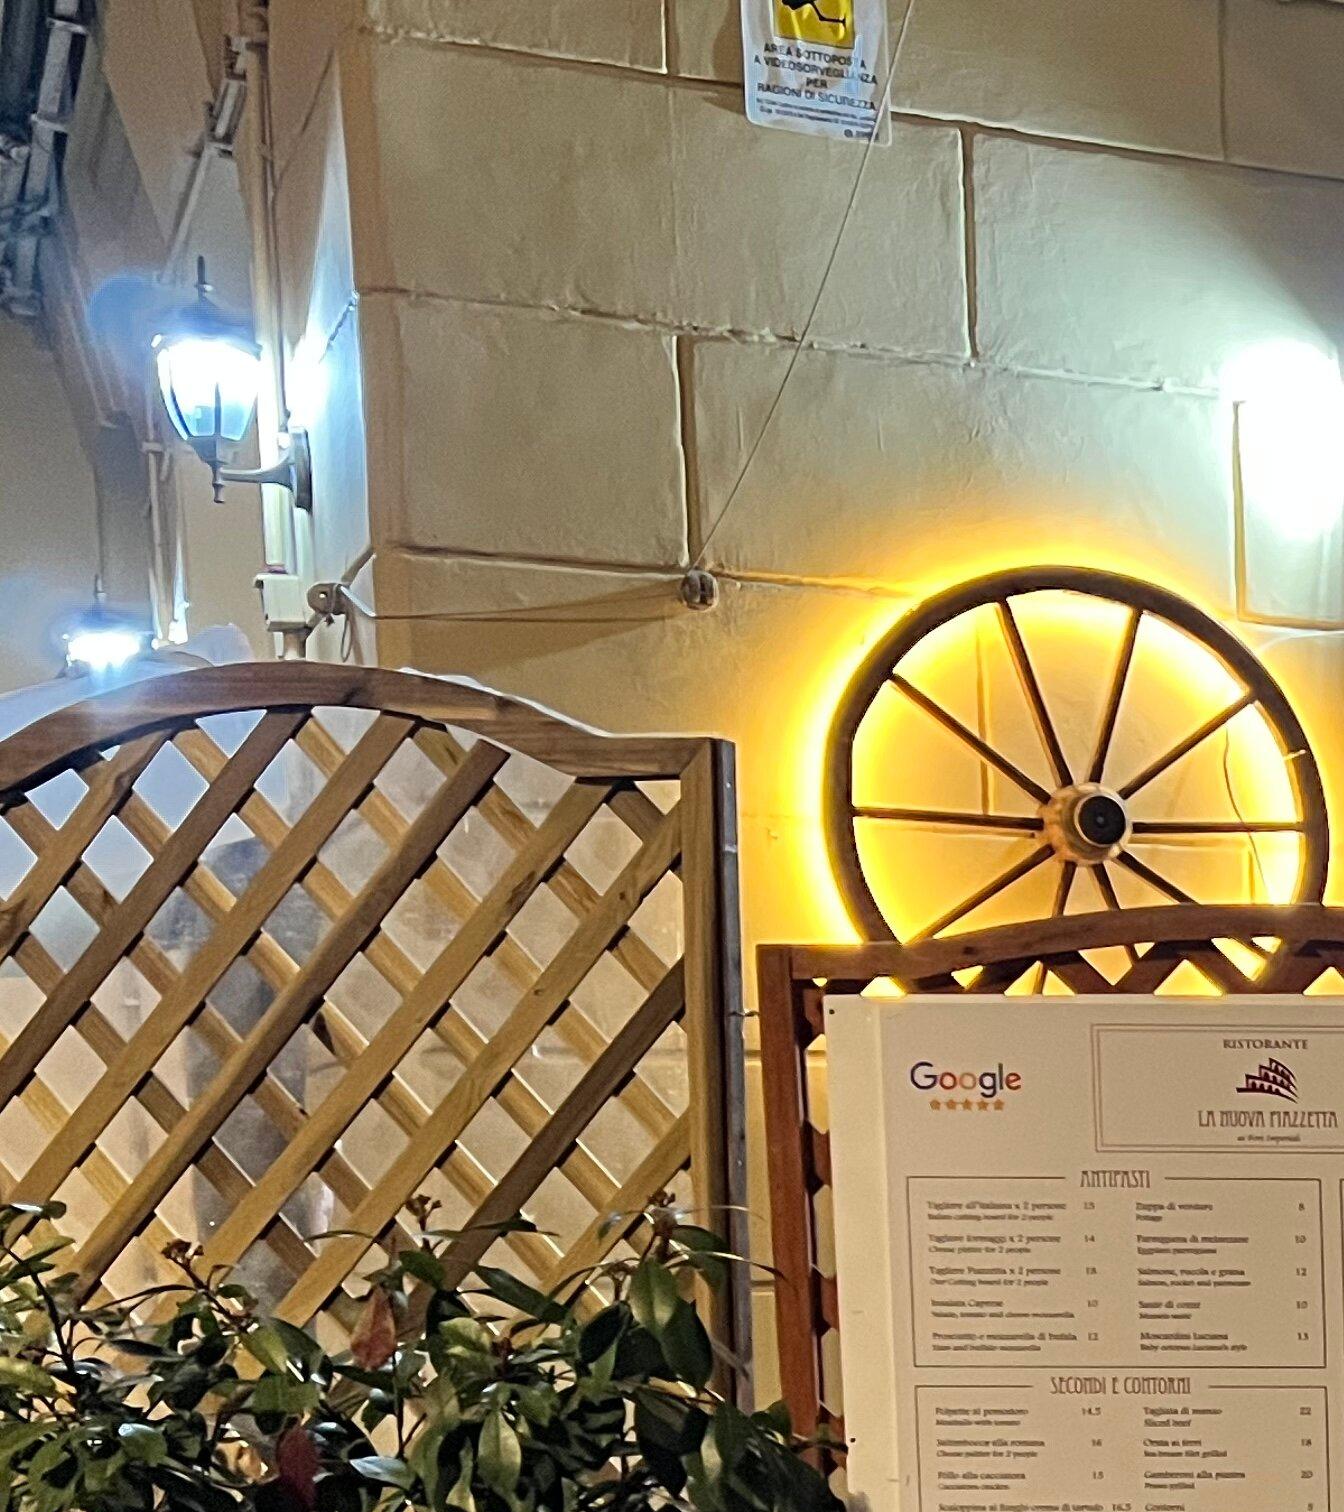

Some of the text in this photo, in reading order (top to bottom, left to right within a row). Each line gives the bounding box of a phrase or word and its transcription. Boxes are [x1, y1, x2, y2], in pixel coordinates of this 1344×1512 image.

[753, 54, 762, 65] A
[796, 48, 867, 69] SOTTOPOSA
[756, 82, 802, 98] RAGIONI
[804, 90, 817, 101] DI
[806, 77, 829, 90] PER
[1223, 1038, 1309, 1051] RISTORANTE
[909, 1061, 1022, 1099] Google
[1197, 1110, 1338, 1129] LA NUOVA PIAZZETTA
[1080, 1170, 1151, 1189] ANTIPASTI
[1050, 1376, 1191, 1395] SECONDI E CONTORNI
